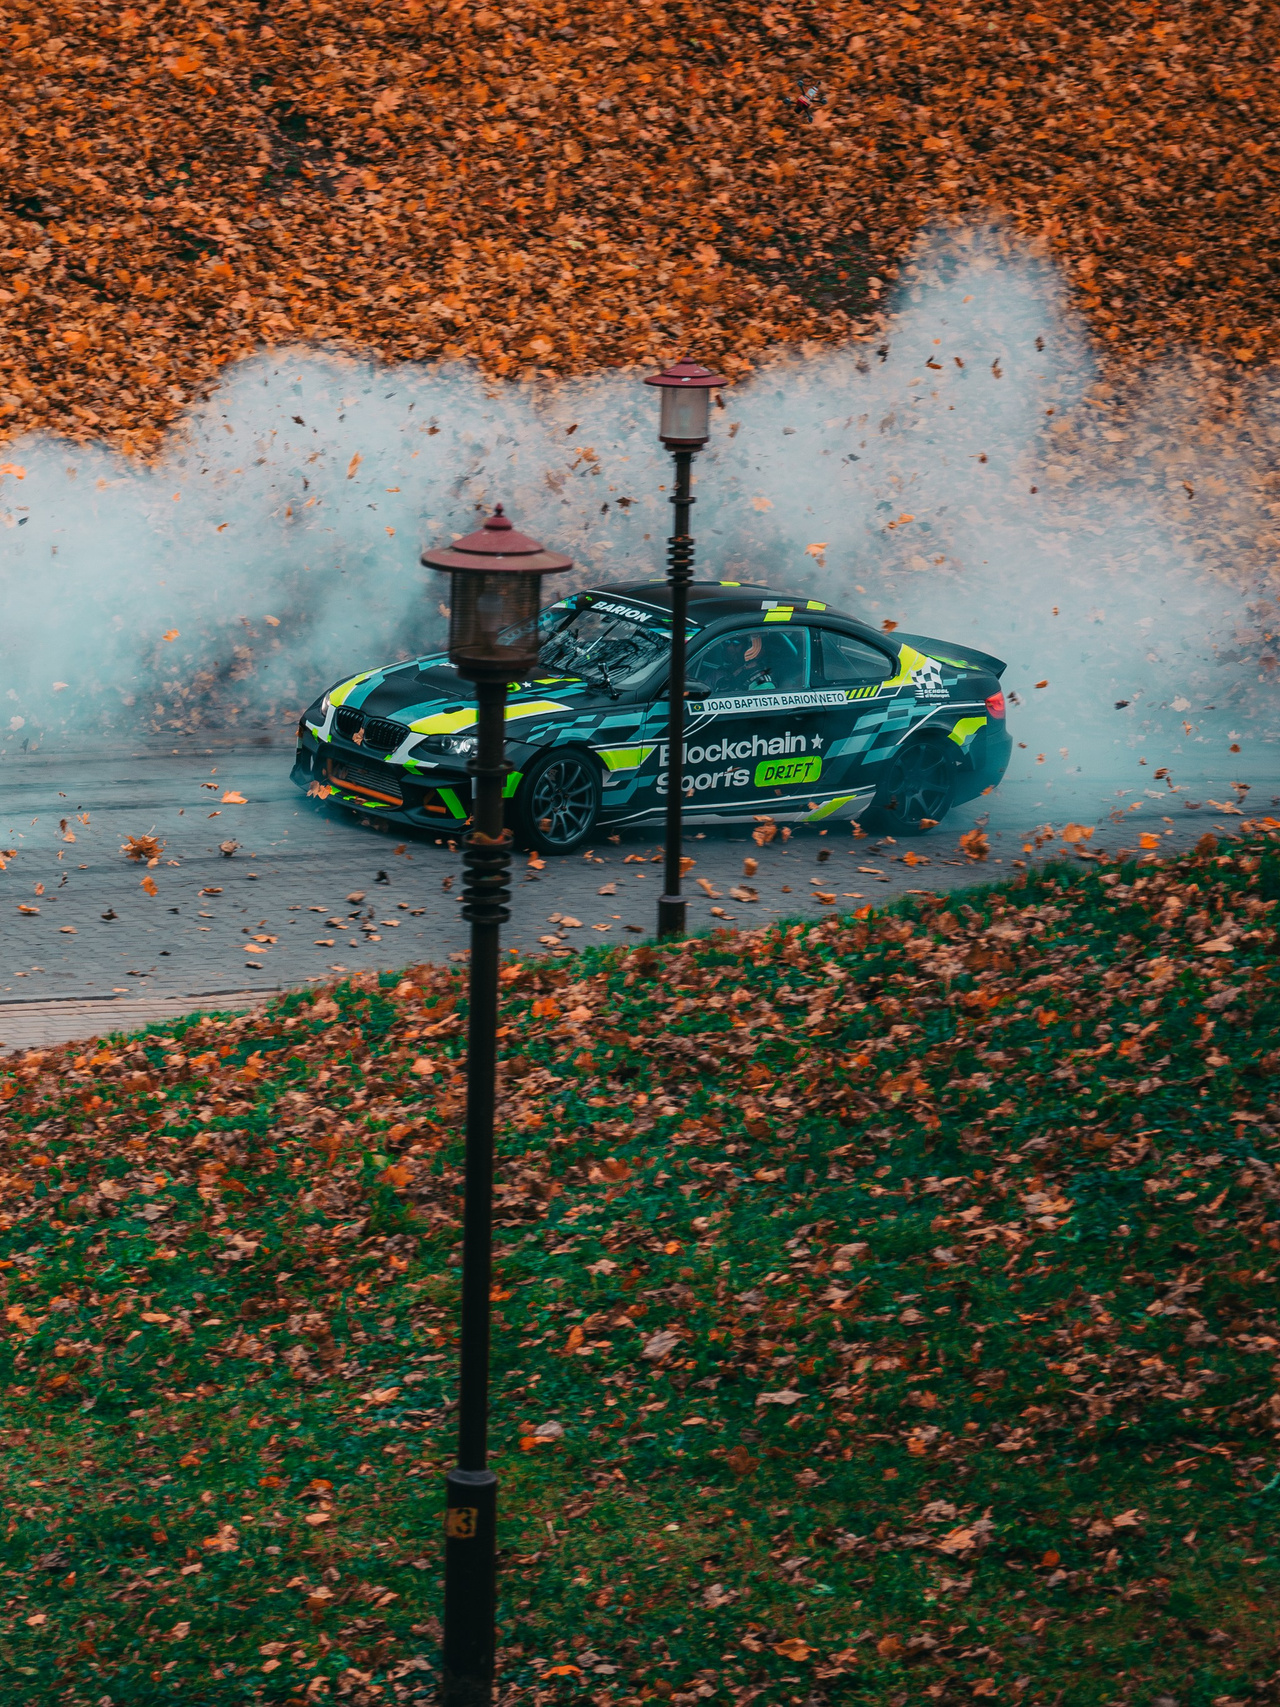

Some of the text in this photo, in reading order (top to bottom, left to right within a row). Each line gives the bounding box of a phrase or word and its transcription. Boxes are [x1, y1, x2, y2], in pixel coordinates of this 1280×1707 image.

[590, 600, 653, 623] BARION
[734, 697, 780, 709] BAPTISTA
[781, 694, 818, 706] BARION
[819, 692, 845, 704] NETO
[659, 731, 807, 767] Blockchain
[655, 762, 814, 795] Sports DRIFT
[456, 1508, 472, 1535] 3
